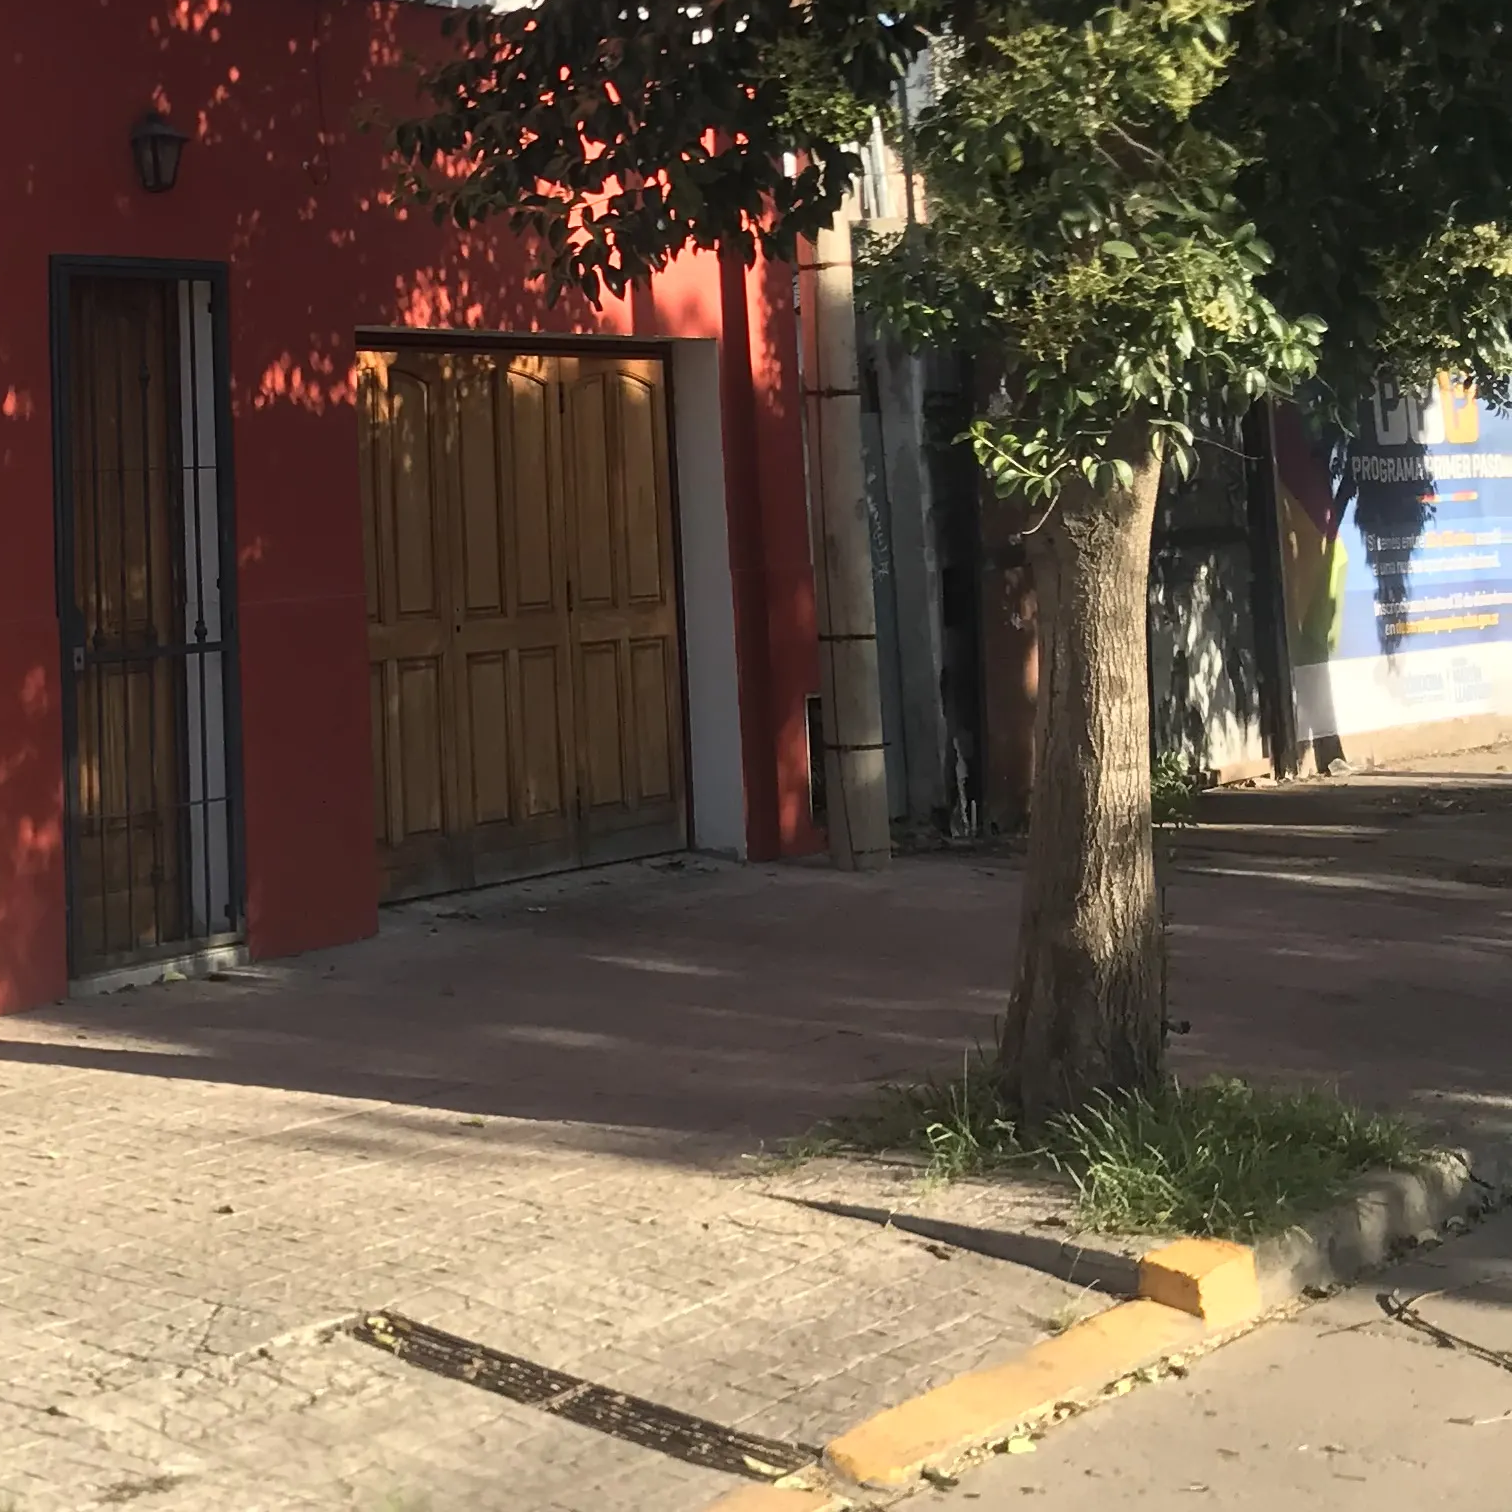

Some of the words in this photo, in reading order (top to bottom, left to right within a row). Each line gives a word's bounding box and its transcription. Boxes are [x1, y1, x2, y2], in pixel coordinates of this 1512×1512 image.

[1352, 455, 1424, 483] PROGRAMA
[1424, 454, 1471, 480] PRIMER
[1472, 453, 1503, 478] PASO
